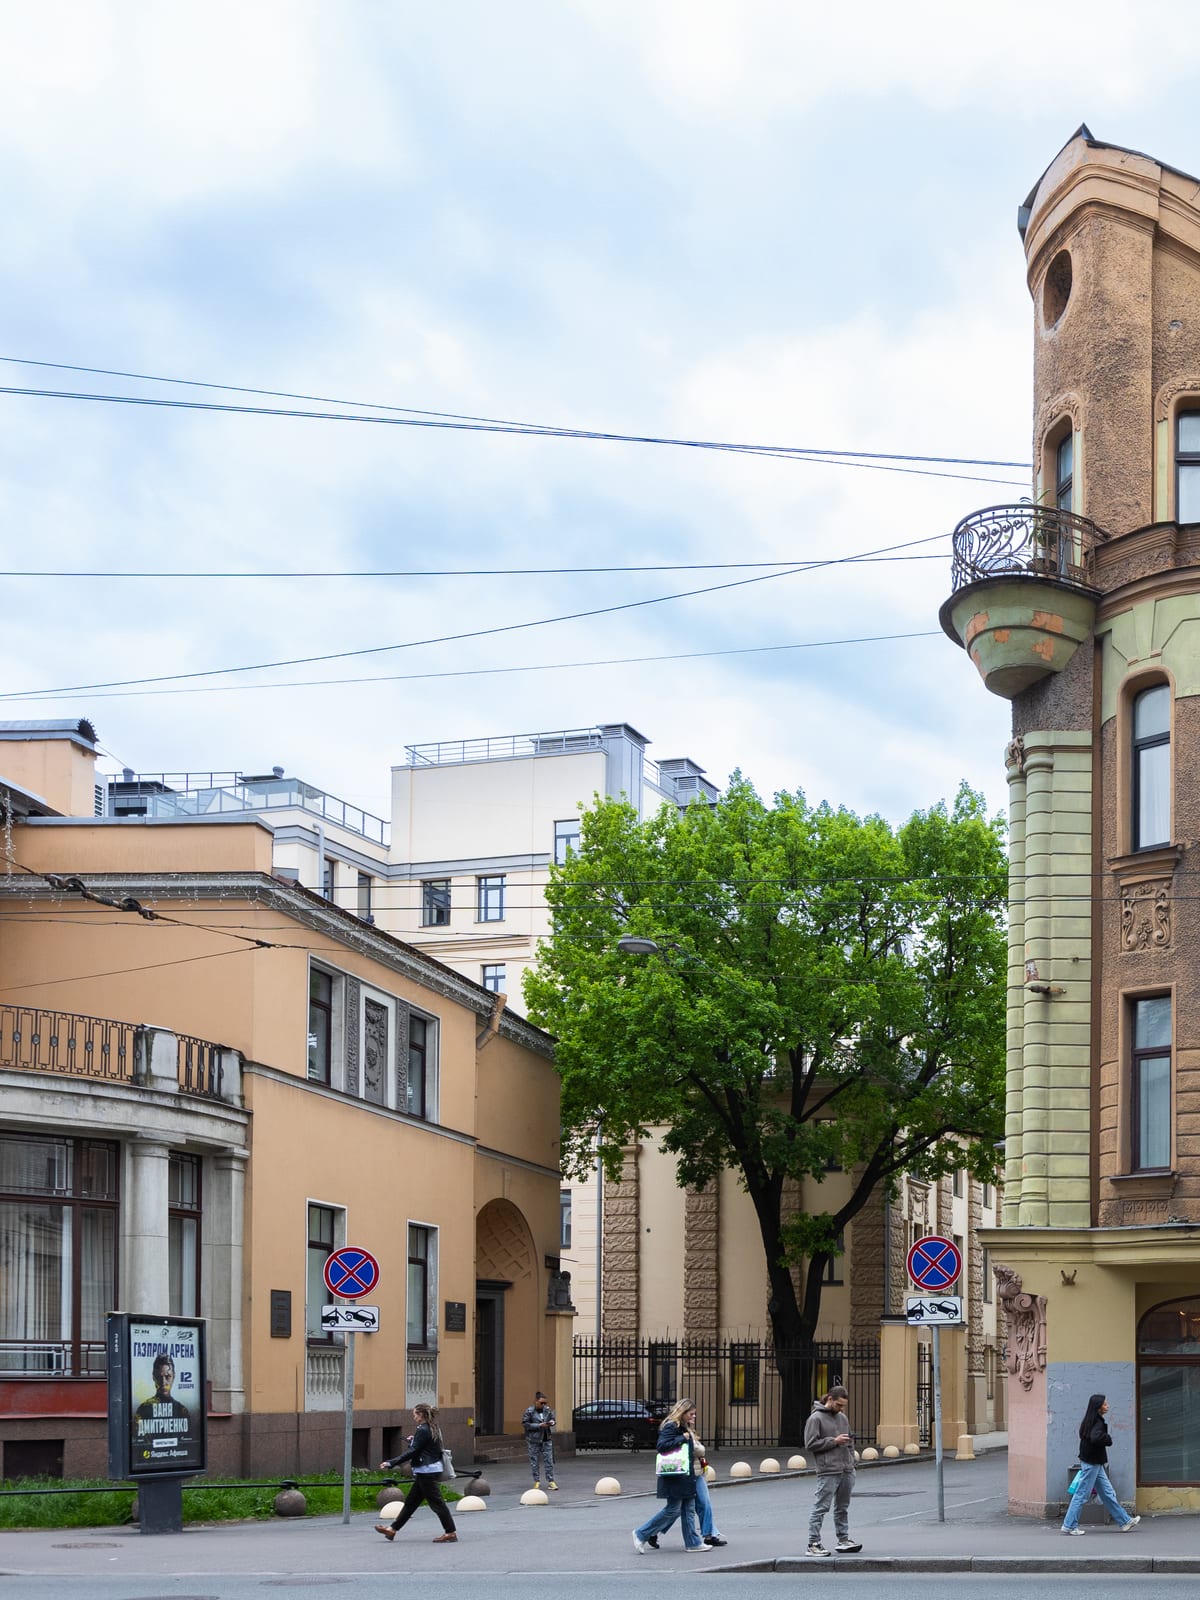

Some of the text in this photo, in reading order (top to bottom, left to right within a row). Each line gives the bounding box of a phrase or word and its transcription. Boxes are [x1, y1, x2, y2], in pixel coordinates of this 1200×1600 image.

[133, 1341, 169, 1358] ГАЗПРОМ
[169, 1343, 195, 1359] АРЕНА
[180, 1372, 192, 1382] 12
[152, 1403, 172, 1417] ВАНЯ
[138, 1418, 188, 1436] ДМИТРИЕНКО
